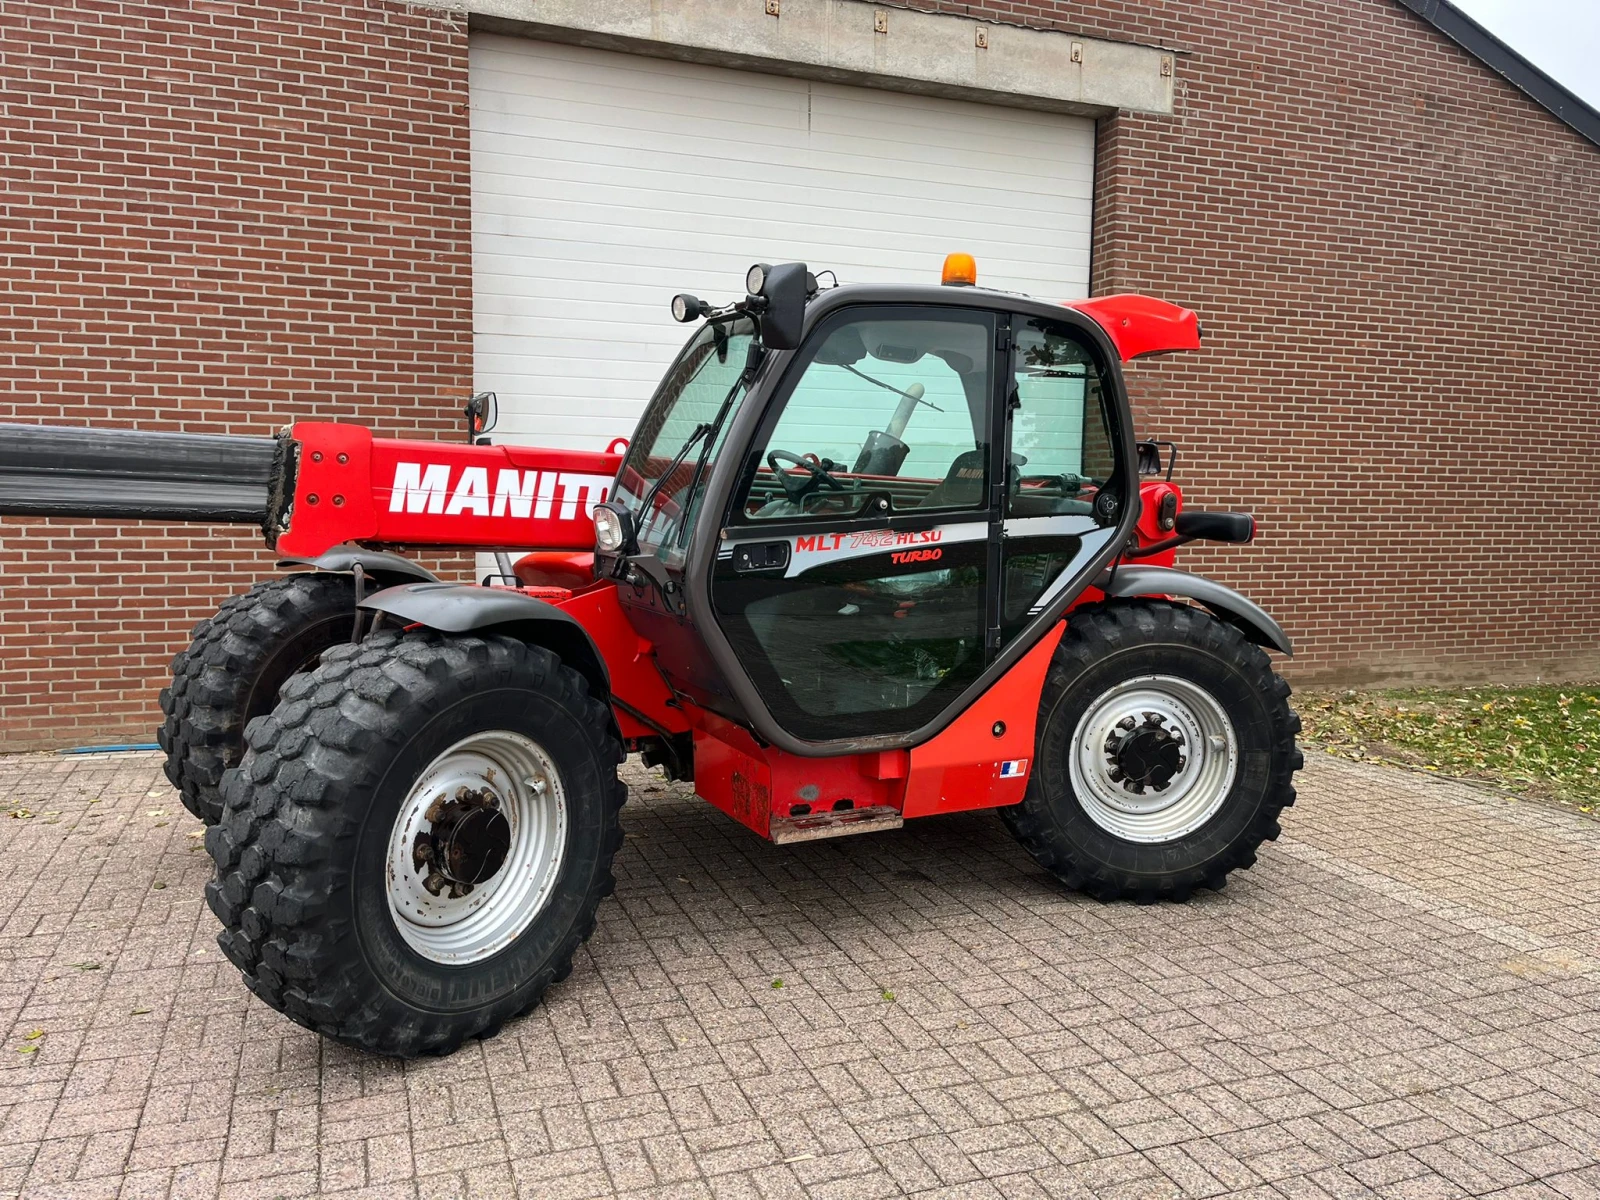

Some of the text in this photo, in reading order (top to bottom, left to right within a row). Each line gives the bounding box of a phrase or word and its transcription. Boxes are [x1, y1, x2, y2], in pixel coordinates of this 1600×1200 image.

[795, 529, 941, 552] MLT 742 HLSU
[891, 548, 942, 564] TURBO
